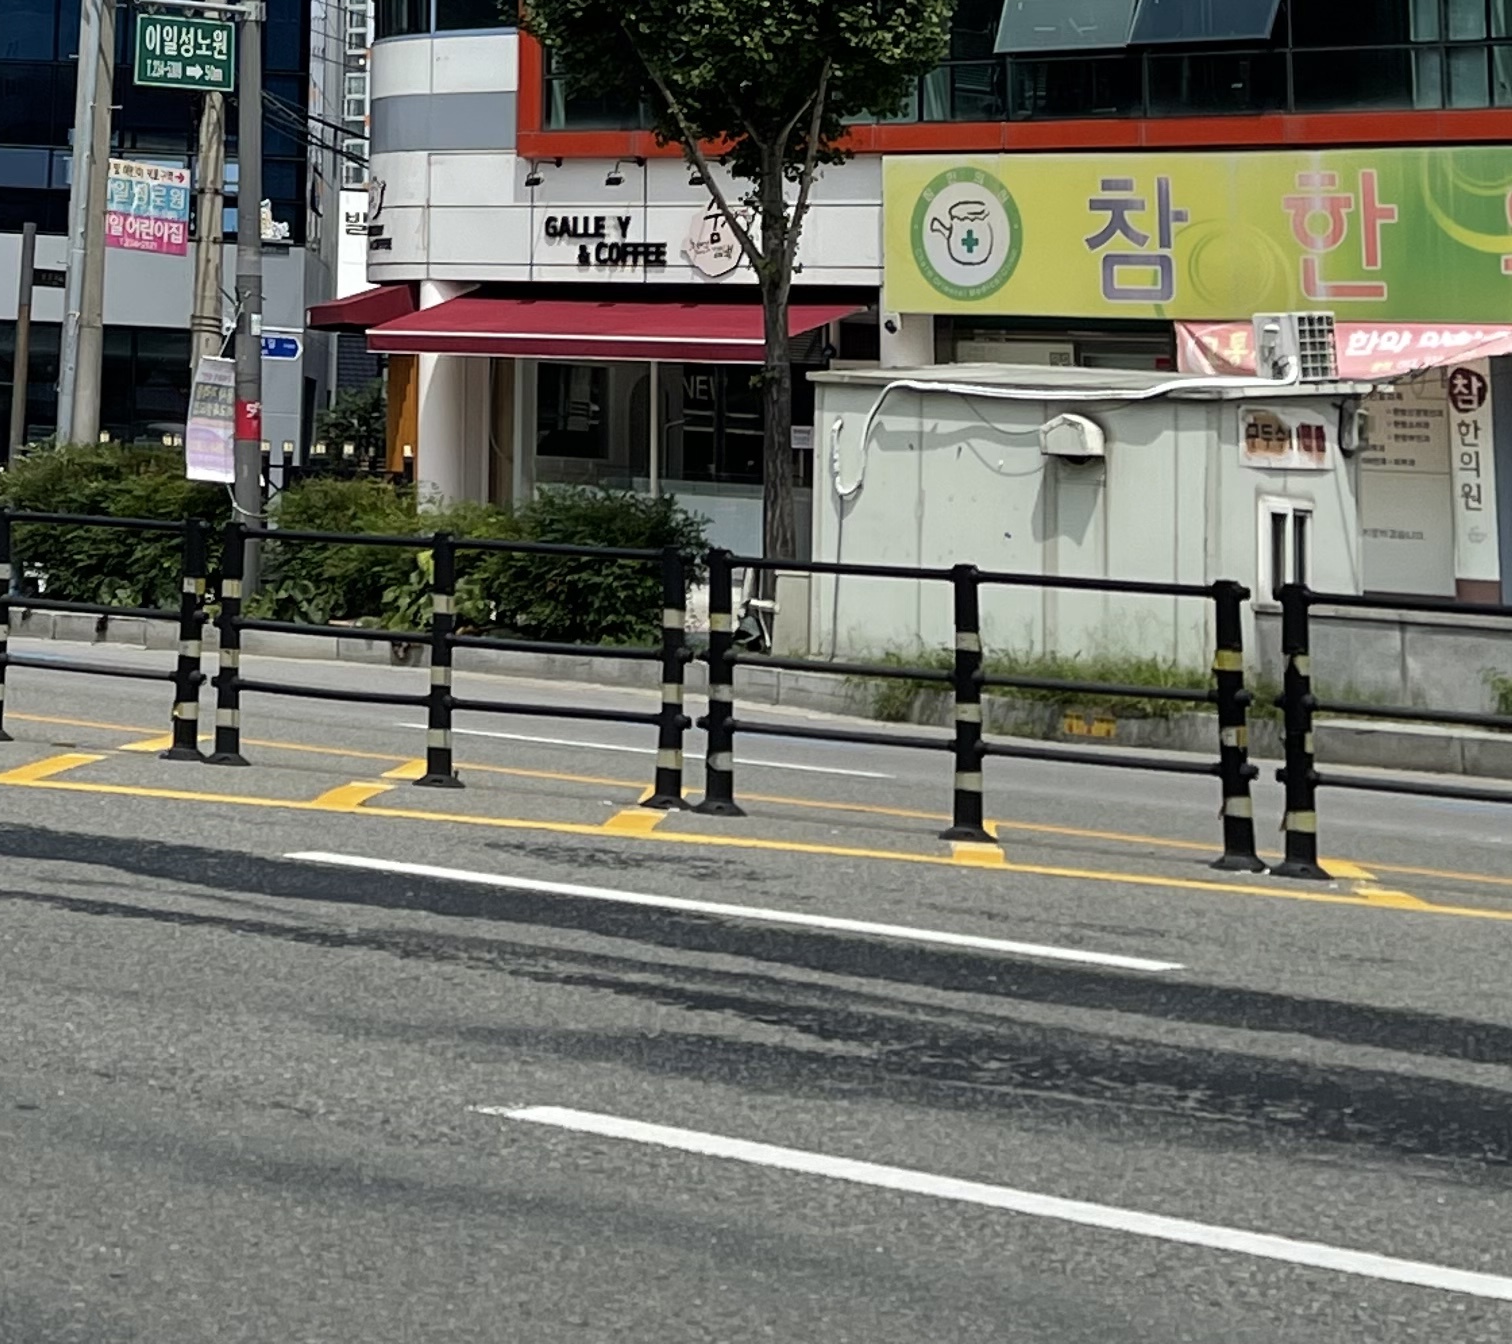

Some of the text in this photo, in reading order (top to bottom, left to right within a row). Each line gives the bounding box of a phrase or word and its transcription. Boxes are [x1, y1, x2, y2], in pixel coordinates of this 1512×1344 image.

[145, 23, 228, 60] 이일성노원
[595, 242, 667, 266] COFFEE
[1451, 373, 1483, 512] 참한의원
